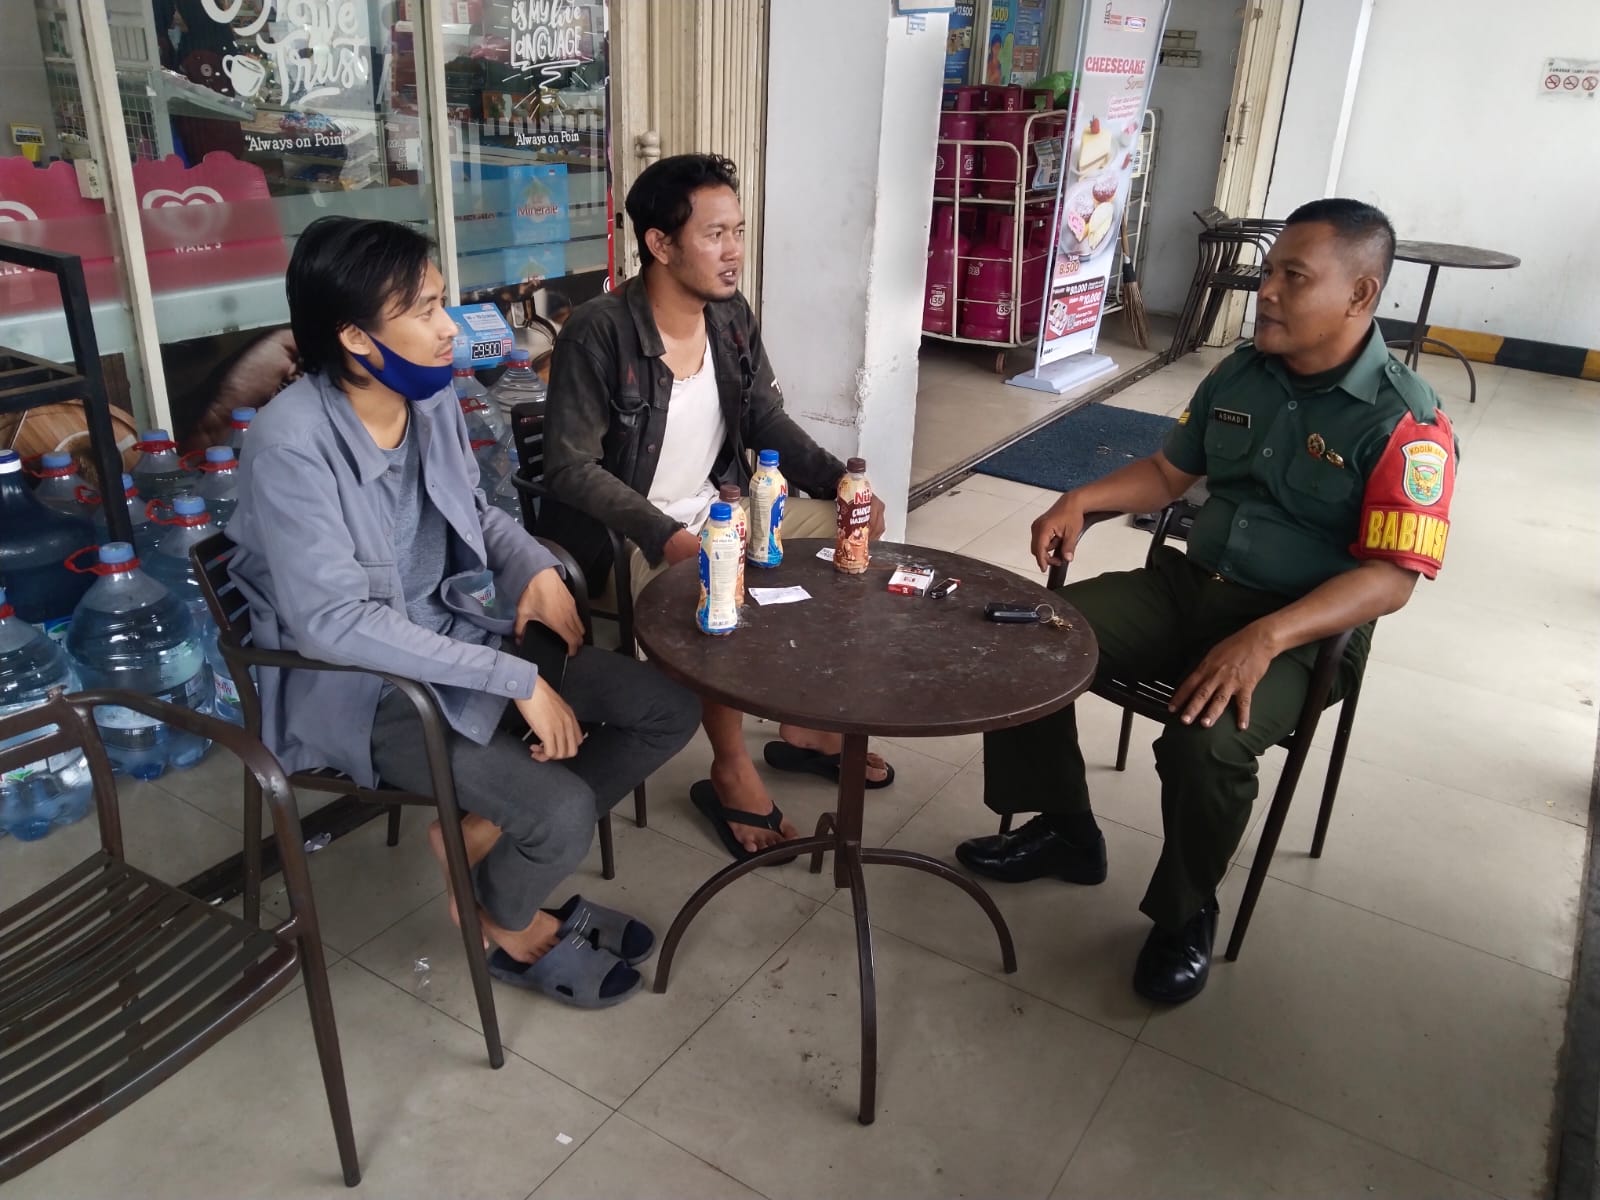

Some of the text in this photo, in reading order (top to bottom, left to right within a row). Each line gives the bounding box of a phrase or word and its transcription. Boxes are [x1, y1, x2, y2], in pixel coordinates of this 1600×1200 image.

[256, 29, 370, 107] Trust
[1085, 56, 1146, 75] CHEESECAKE
[295, 137, 312, 148] on
[548, 134, 559, 143] on
[1218, 412, 1244, 425] ASHADI
